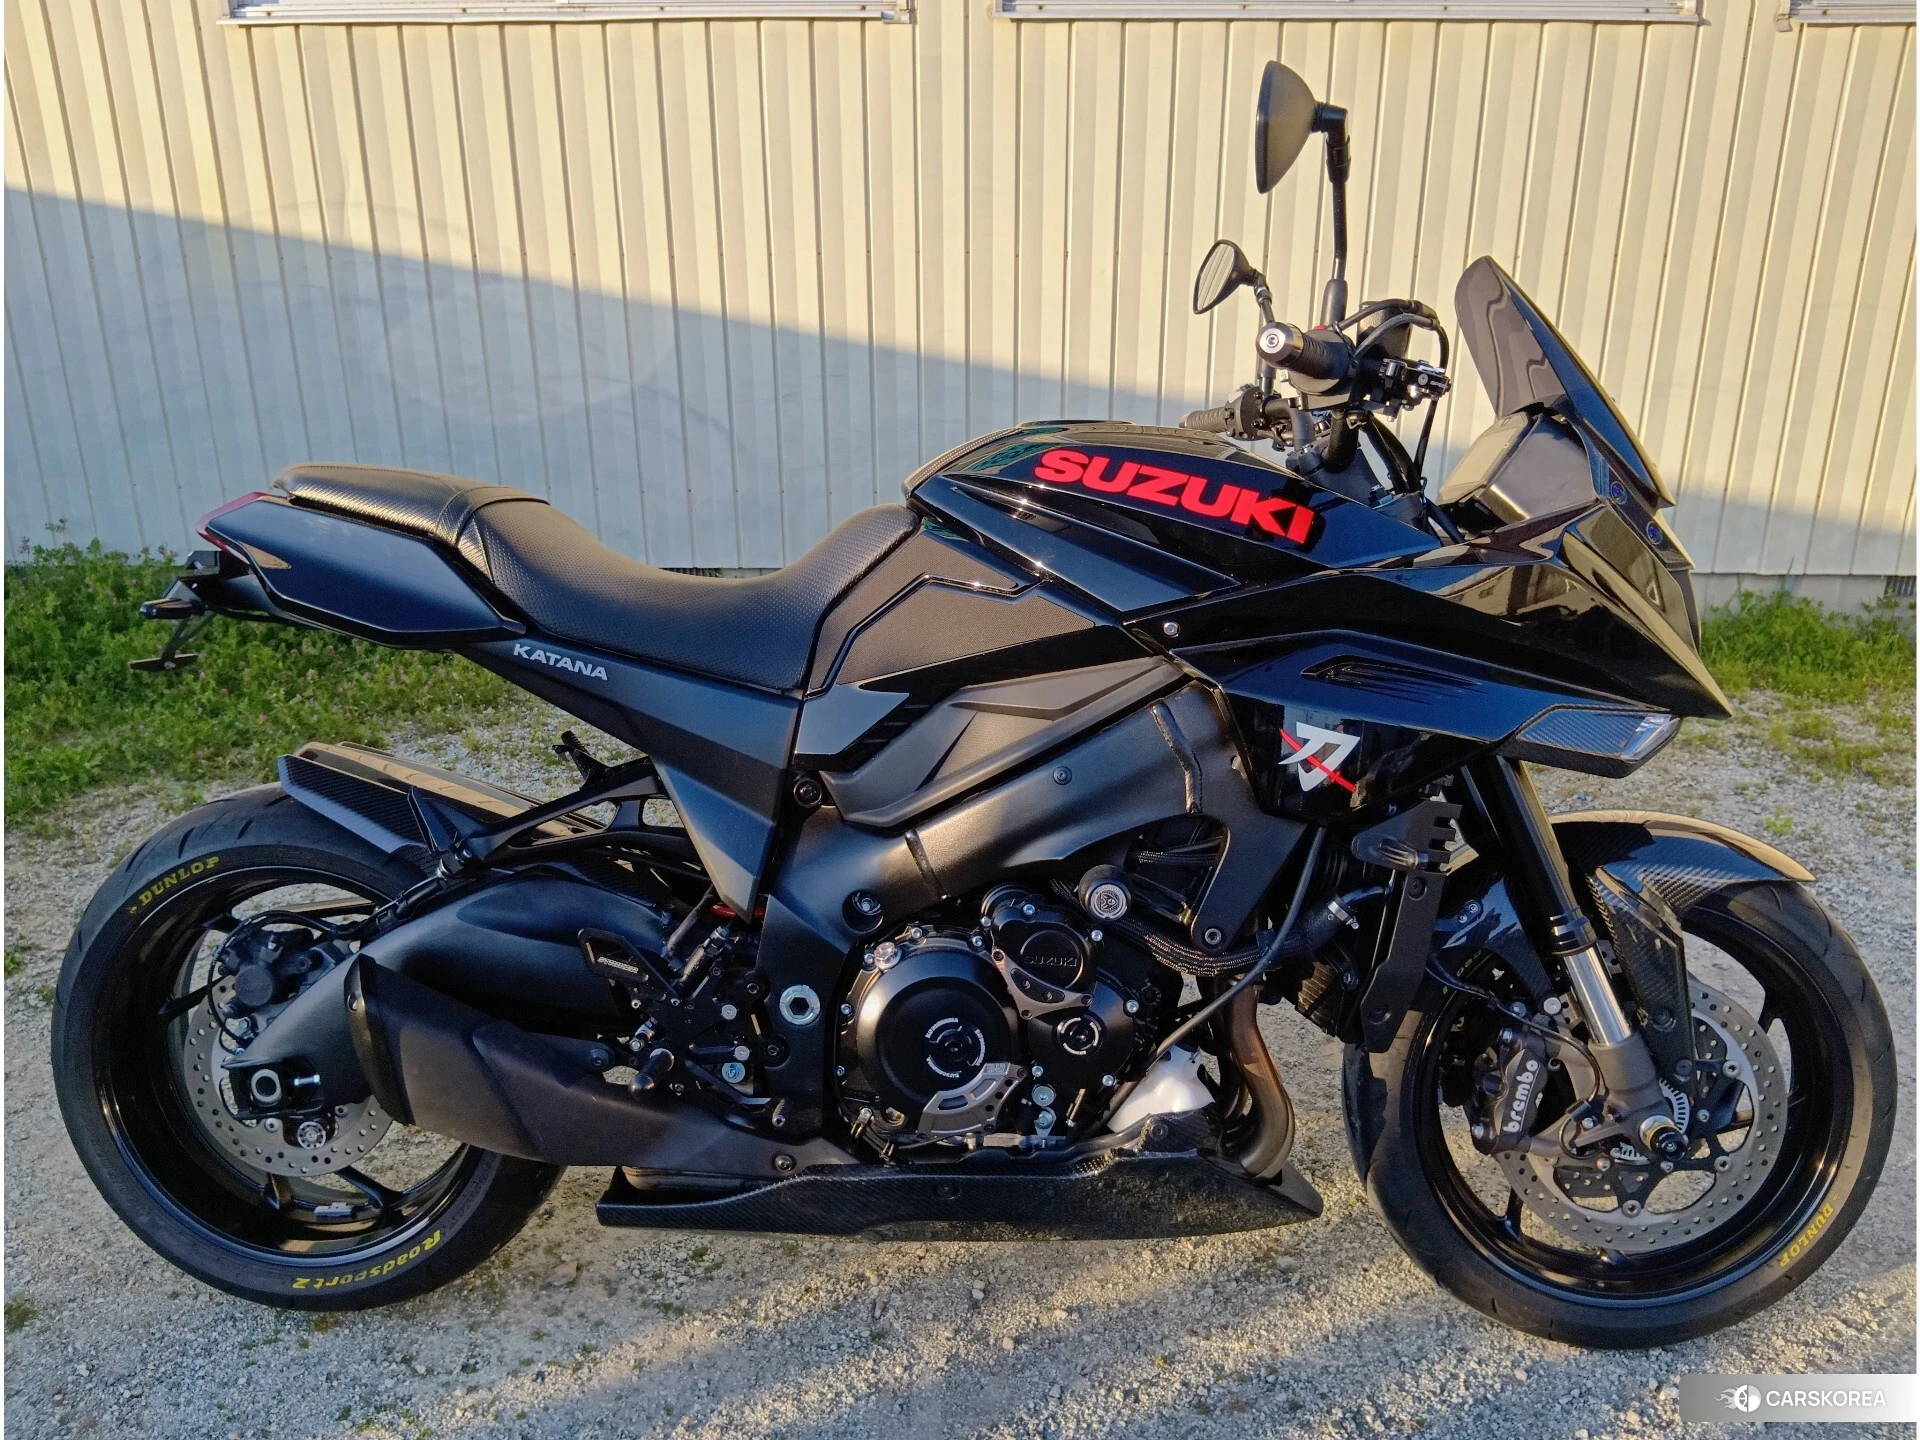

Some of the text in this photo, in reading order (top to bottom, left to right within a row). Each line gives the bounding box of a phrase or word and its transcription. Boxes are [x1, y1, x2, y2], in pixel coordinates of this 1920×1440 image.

[1034, 449, 1316, 545] SUZUKI
[513, 643, 608, 681] KATANA
[138, 855, 220, 907] DUNLOP
[1023, 955, 1077, 967] SUZUKI
[1502, 1059, 1539, 1133] brembo
[1779, 1202, 1834, 1268] DUNLOP
